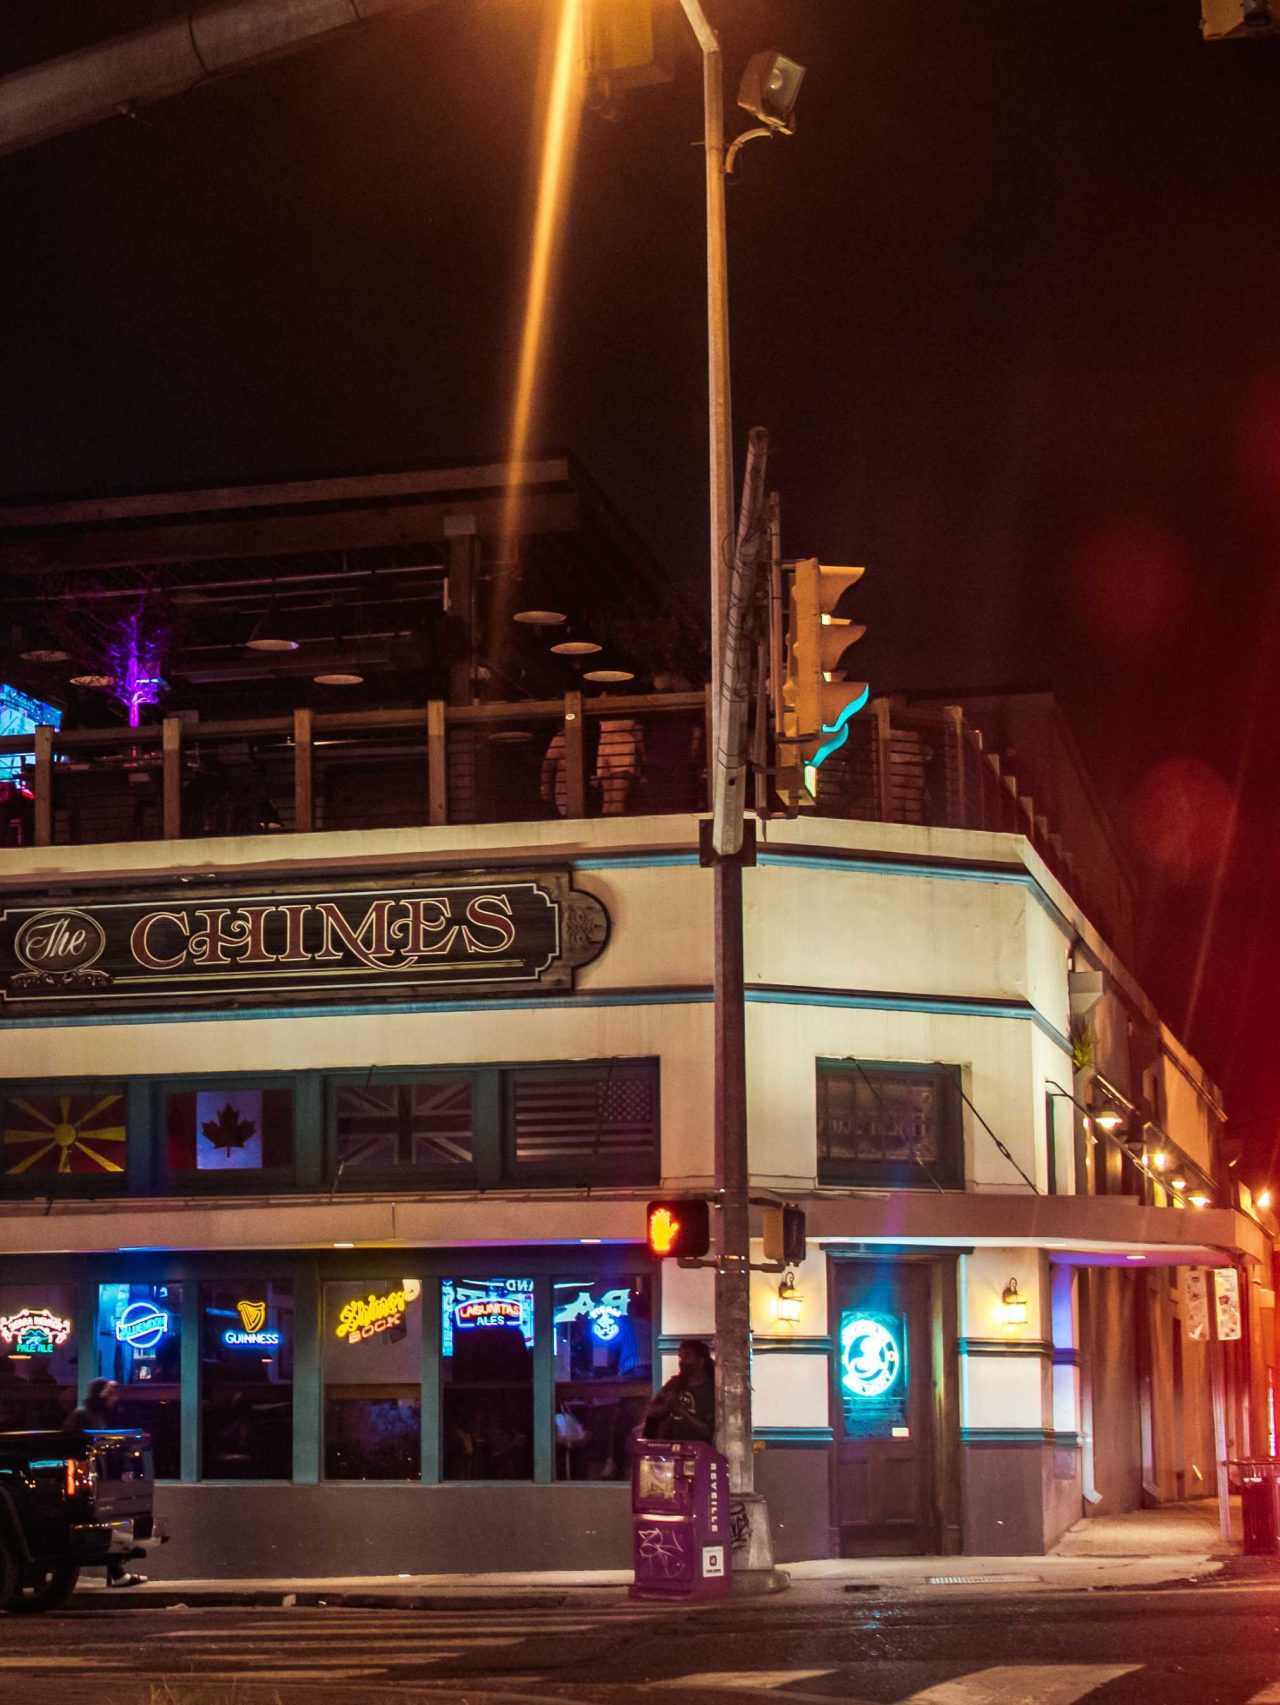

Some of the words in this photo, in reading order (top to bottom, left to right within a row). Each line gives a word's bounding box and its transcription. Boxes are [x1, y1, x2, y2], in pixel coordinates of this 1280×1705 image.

[25, 915, 88, 961] The
[130, 894, 516, 972] CHIMES
[460, 1303, 520, 1318] LAGUNITAS
[477, 1316, 505, 1326] ALES
[348, 1313, 401, 1344] BOCK
[225, 1332, 279, 1344] GUINNESS
[16, 1344, 36, 1353] PALE
[37, 1344, 54, 1353] ALE
